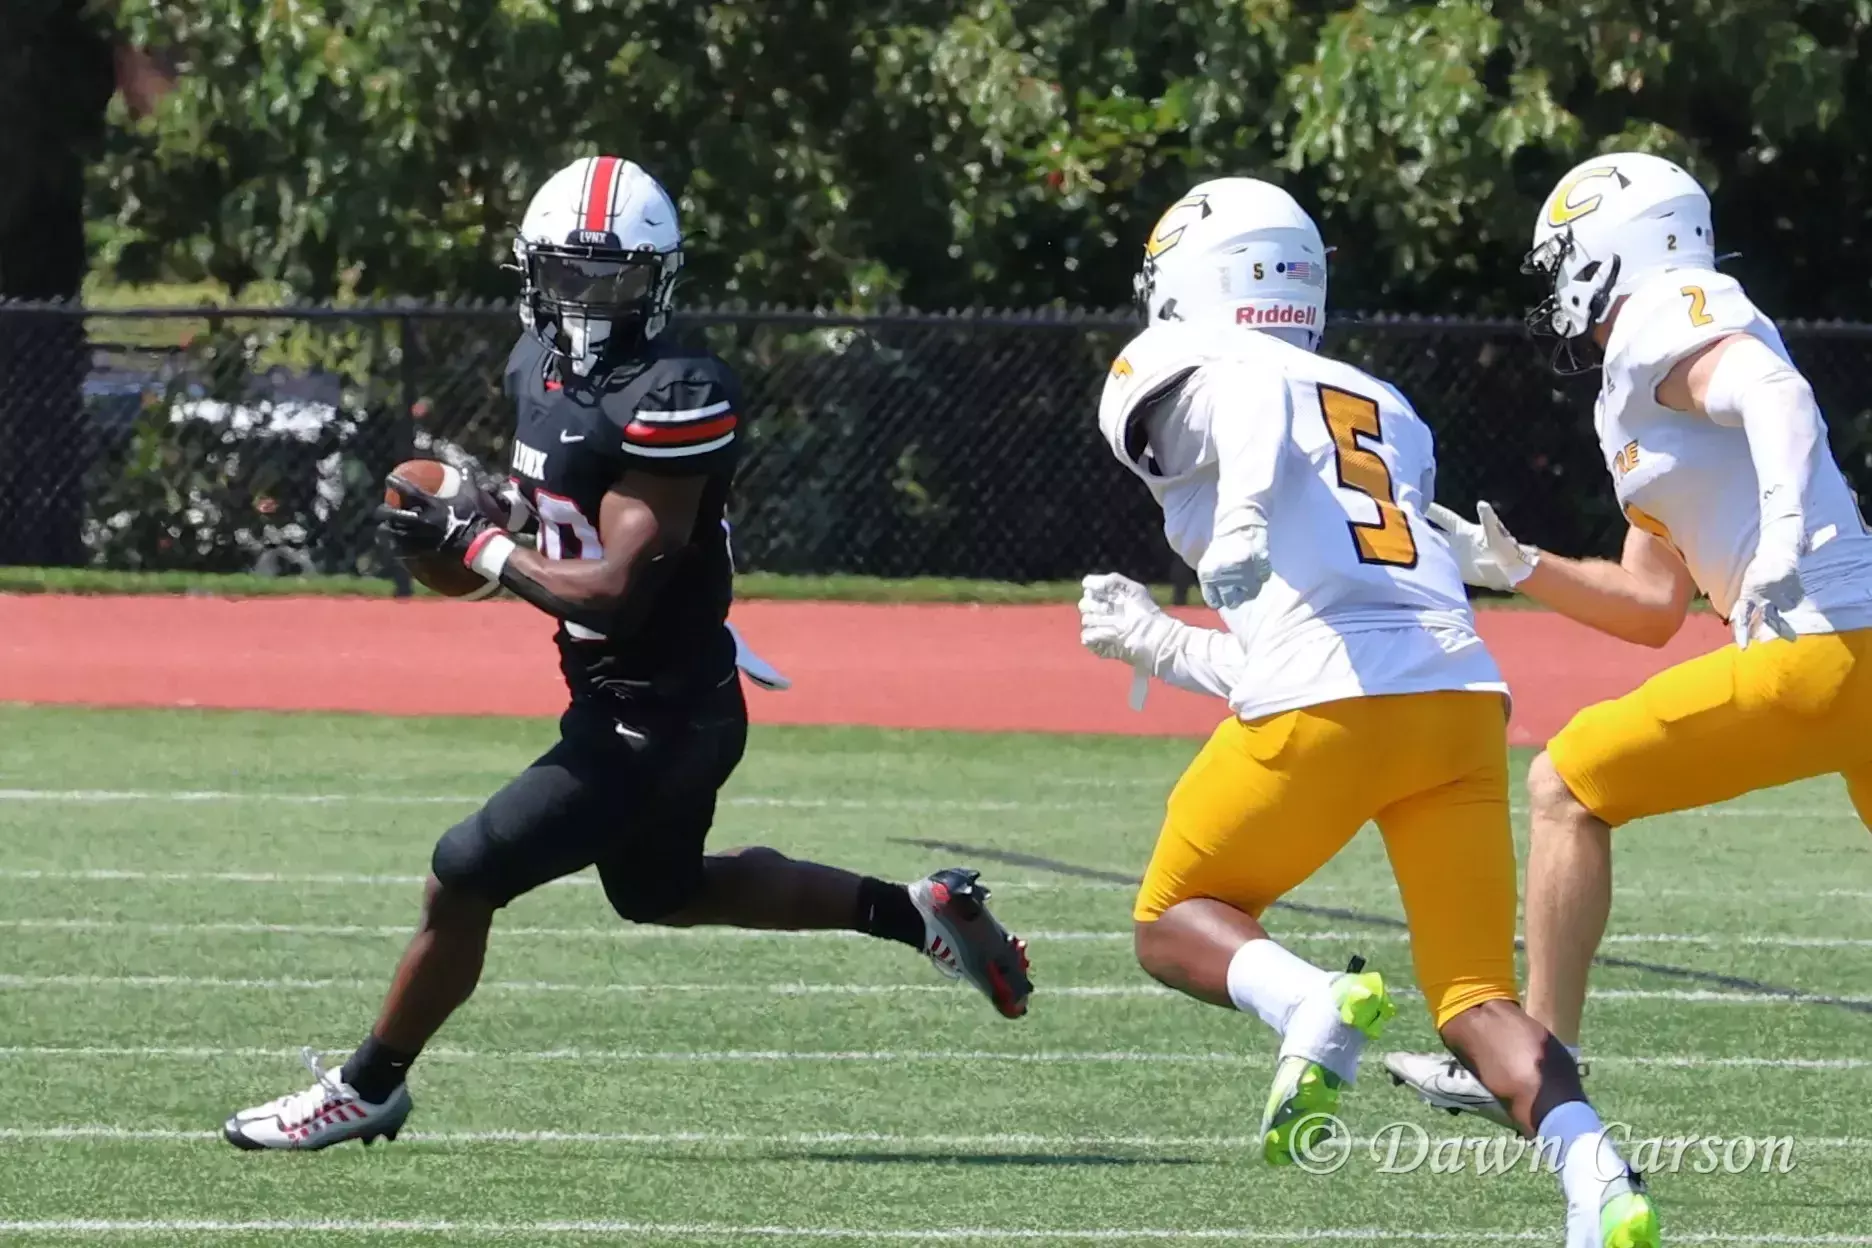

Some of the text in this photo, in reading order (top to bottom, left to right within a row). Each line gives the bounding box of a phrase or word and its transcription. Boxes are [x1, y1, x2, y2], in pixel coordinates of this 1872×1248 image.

[579, 231, 607, 244] LYNX
[1667, 234, 1677, 250] 2
[1253, 262, 1264, 280] 5
[1236, 304, 1317, 325] Riddell
[1680, 285, 1714, 328] 2
[1316, 381, 1418, 570] 5
